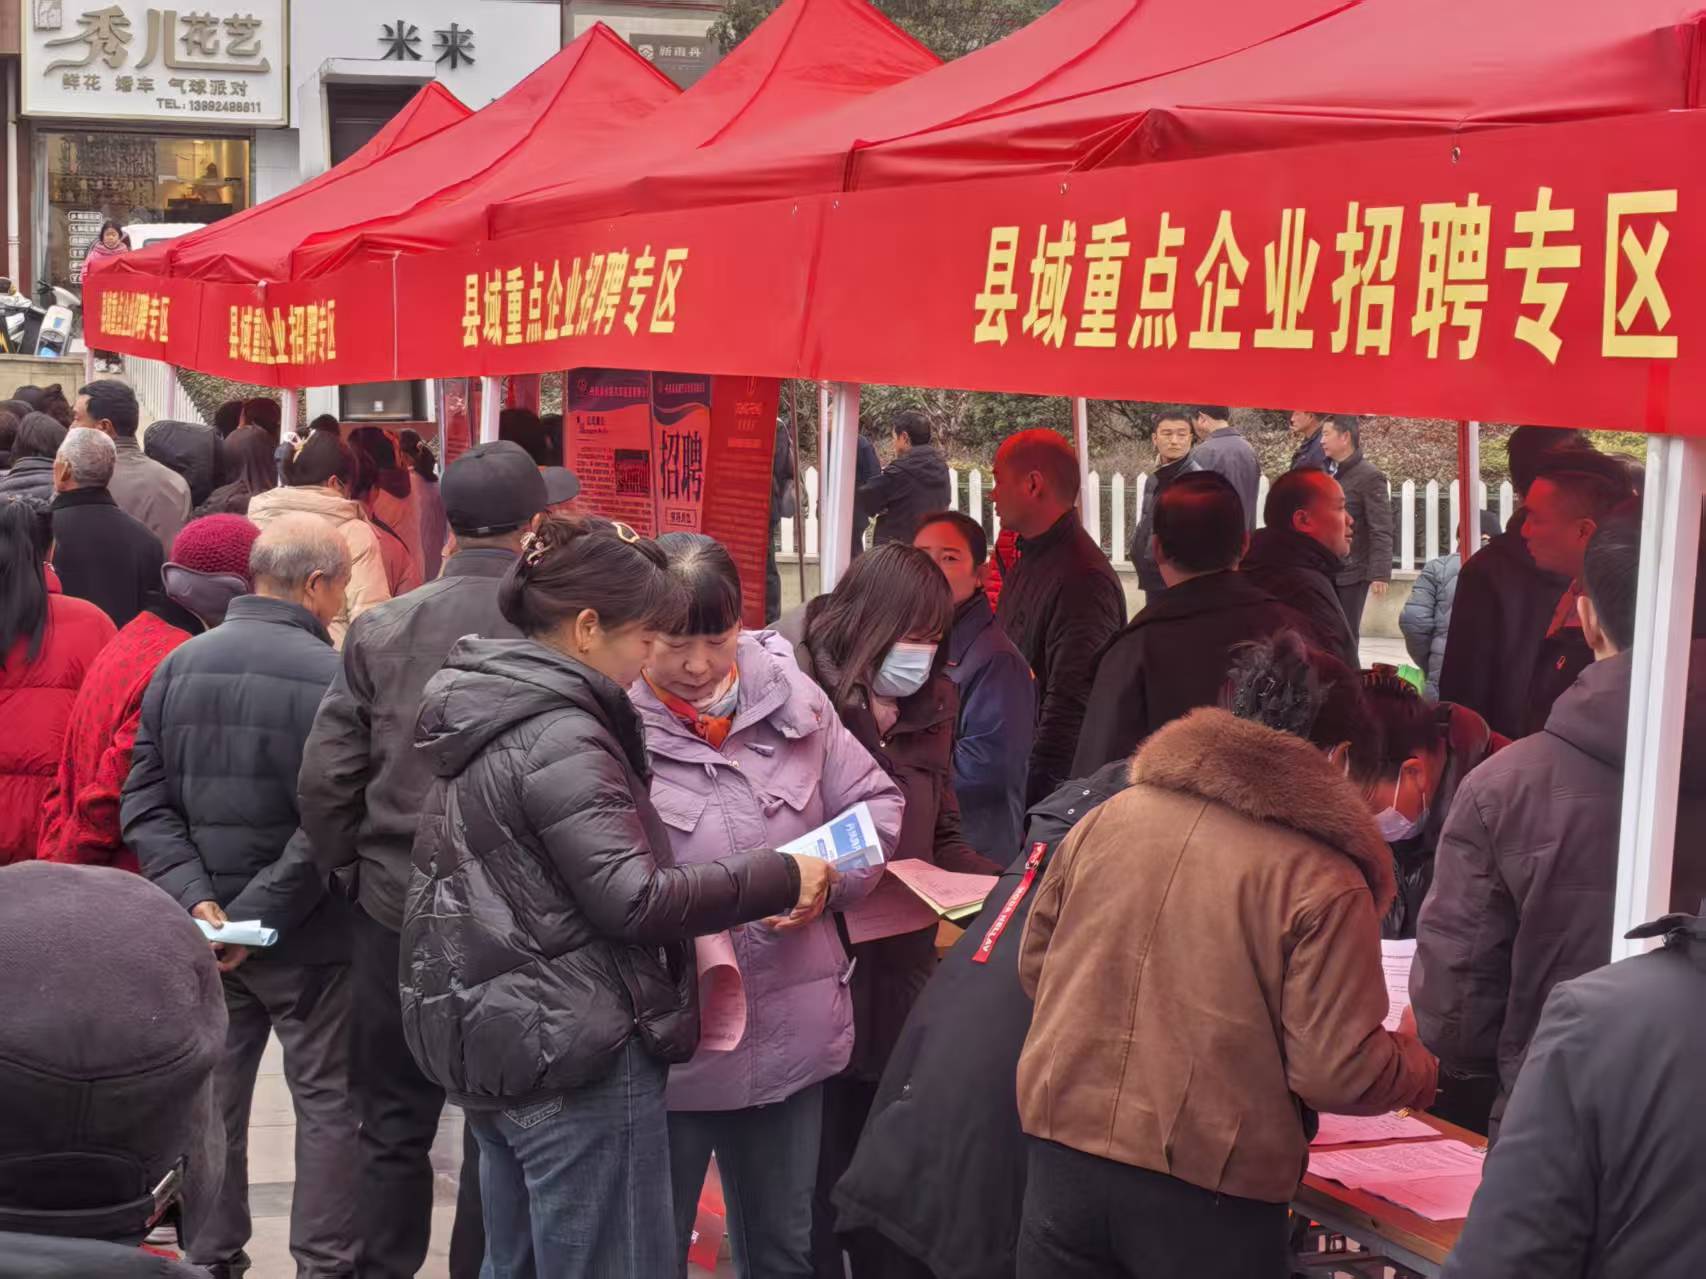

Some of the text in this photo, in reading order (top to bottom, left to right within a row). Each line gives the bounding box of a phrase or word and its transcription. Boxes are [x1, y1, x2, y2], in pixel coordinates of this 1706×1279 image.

[377, 19, 477, 69] 米来
[62, 73, 101, 92] 鲜花
[168, 78, 249, 97] 气球派对
[462, 244, 689, 348] 县域重点企业招聘专区
[973, 186, 1679, 365] 县域重点企业招聘专区
[659, 430, 704, 502] 招聘
